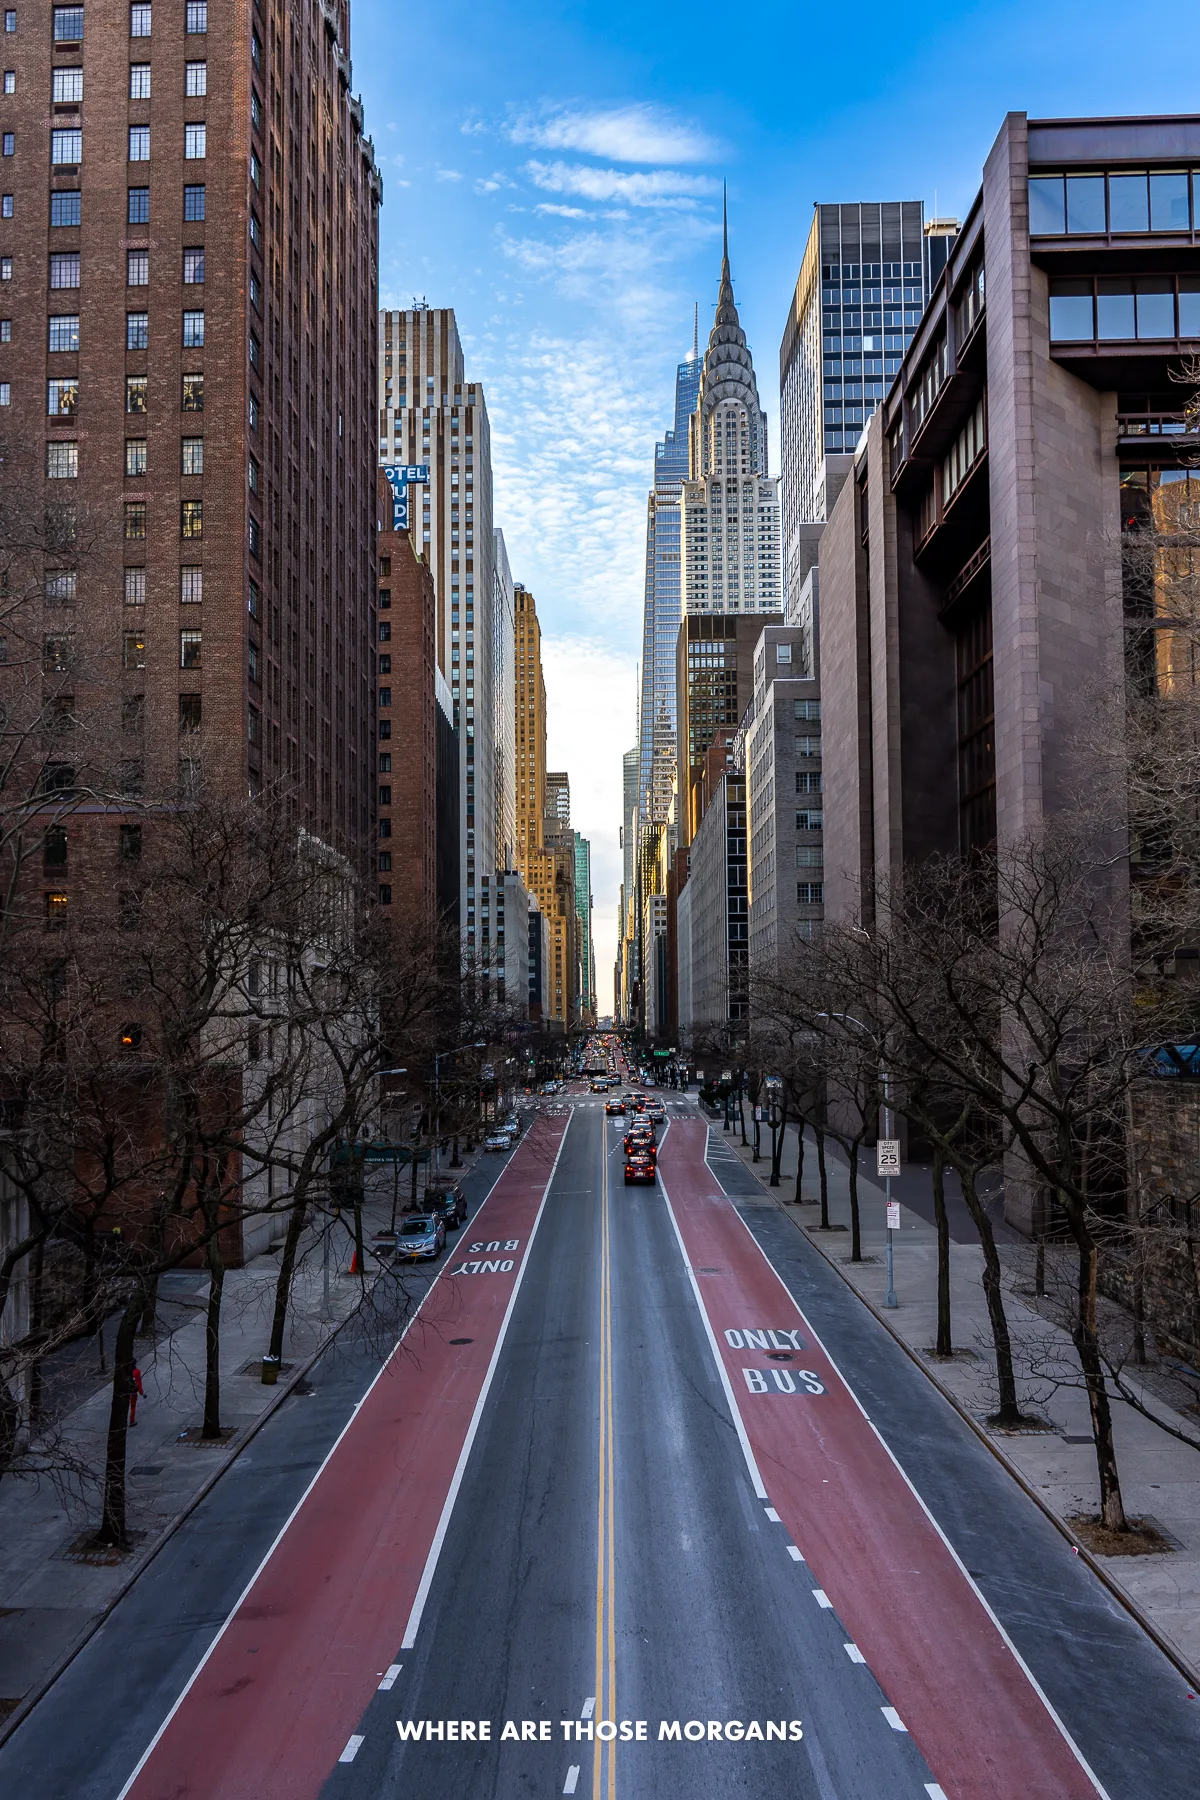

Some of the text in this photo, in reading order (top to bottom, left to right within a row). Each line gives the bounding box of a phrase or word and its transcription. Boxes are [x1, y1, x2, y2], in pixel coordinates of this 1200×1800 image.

[881, 1154, 897, 1164] 25
[469, 1240, 520, 1253] BUS
[450, 1260, 514, 1276] ONLY
[724, 1328, 801, 1350] ONLY
[742, 1368, 824, 1394] BUS
